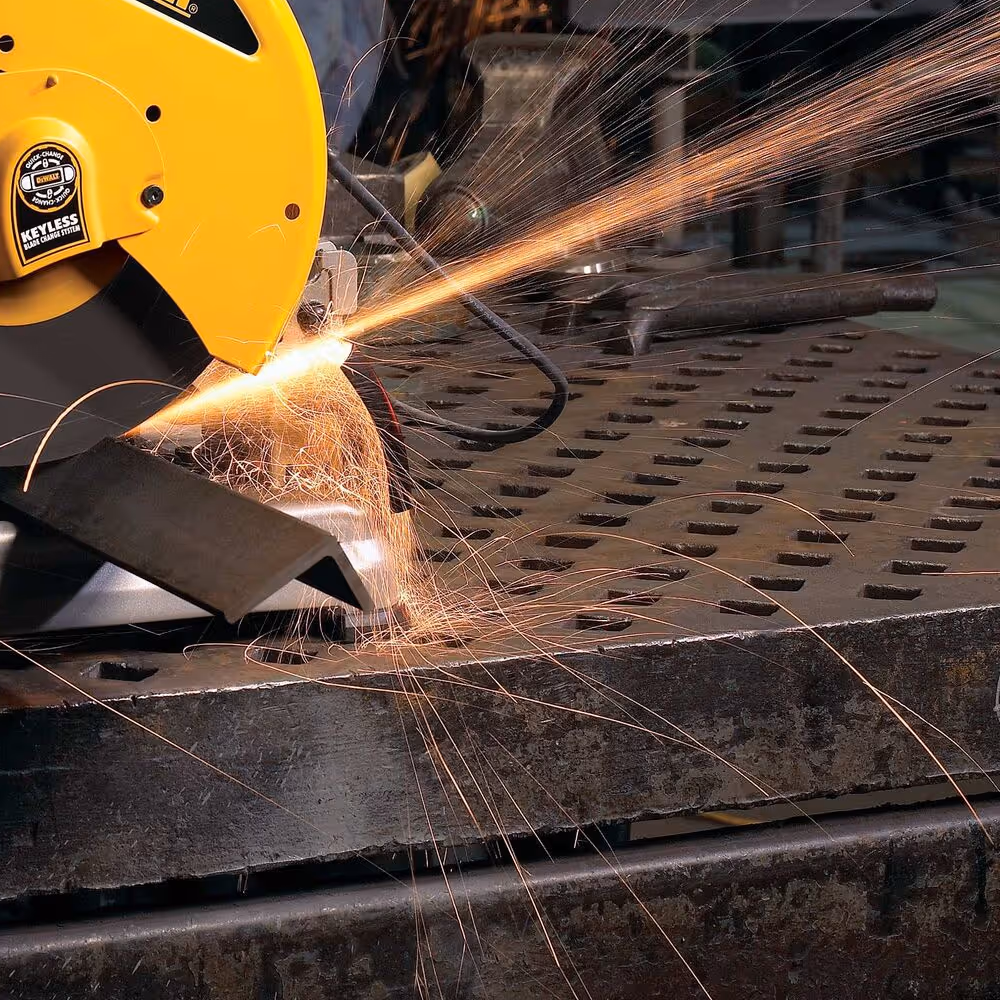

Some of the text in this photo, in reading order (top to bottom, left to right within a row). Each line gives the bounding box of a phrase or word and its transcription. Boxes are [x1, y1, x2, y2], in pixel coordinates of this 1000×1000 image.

[25, 151, 64, 169] QUICK-CHANGE
[20, 213, 78, 243] KEYLESS
[23, 225, 80, 250] BLADE CHANGE SYSTEM
